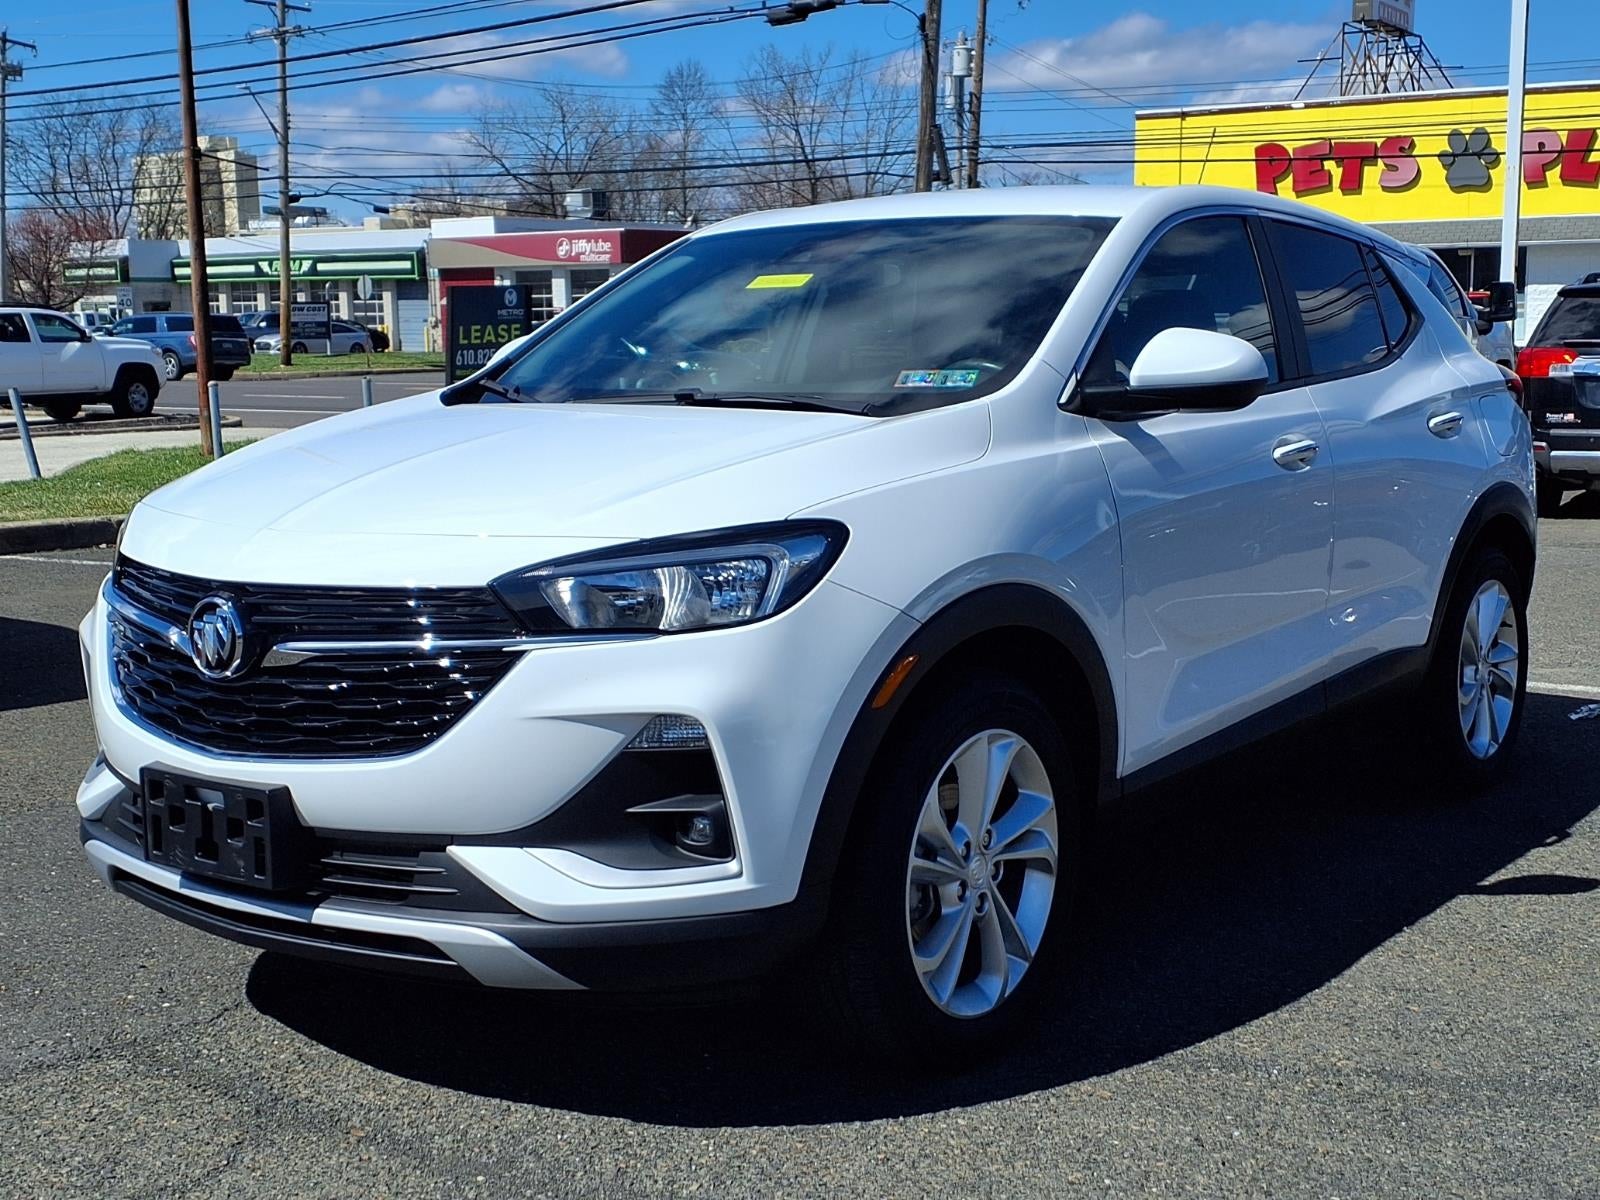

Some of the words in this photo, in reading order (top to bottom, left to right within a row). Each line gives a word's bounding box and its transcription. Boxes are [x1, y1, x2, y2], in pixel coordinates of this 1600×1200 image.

[1254, 136, 1421, 197] PETS
[118, 298, 132, 307] 40
[459, 324, 521, 345] LEASE
